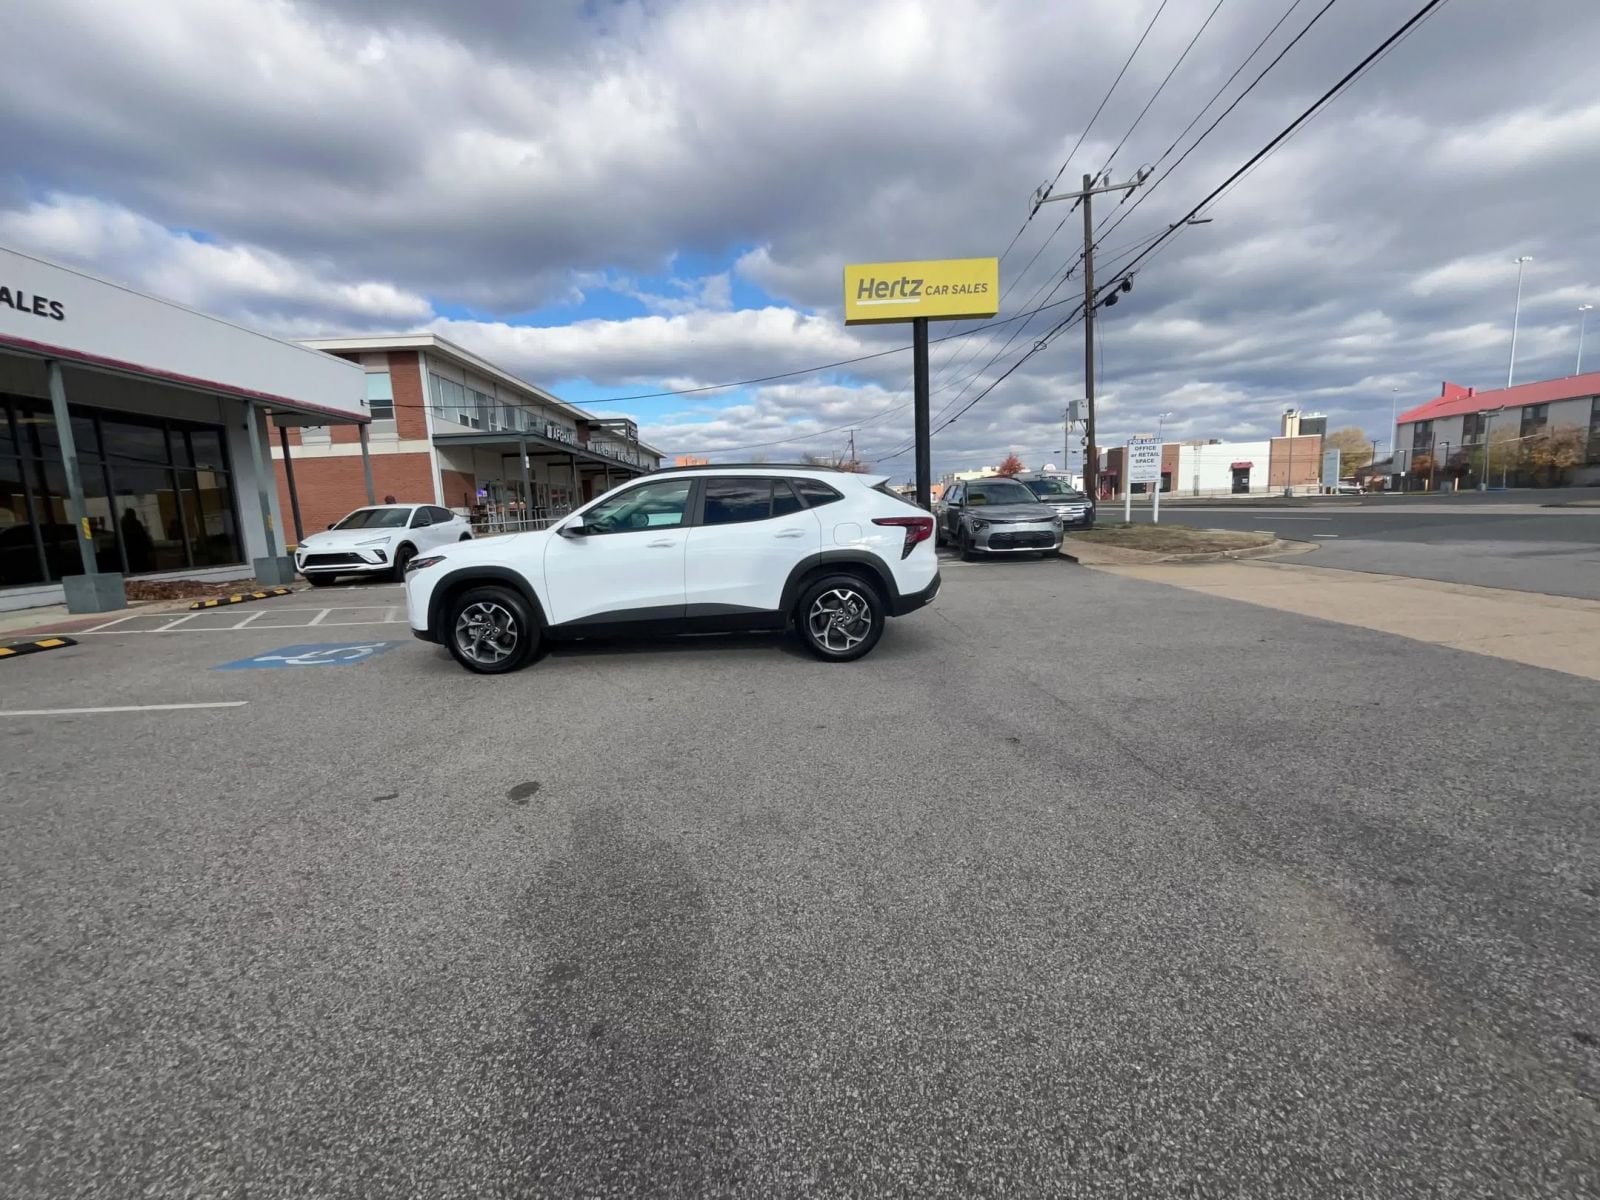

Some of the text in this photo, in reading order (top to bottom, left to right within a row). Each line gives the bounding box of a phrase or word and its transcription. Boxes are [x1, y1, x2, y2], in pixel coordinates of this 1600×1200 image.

[857, 277, 988, 300] Hertz CAR SALES
